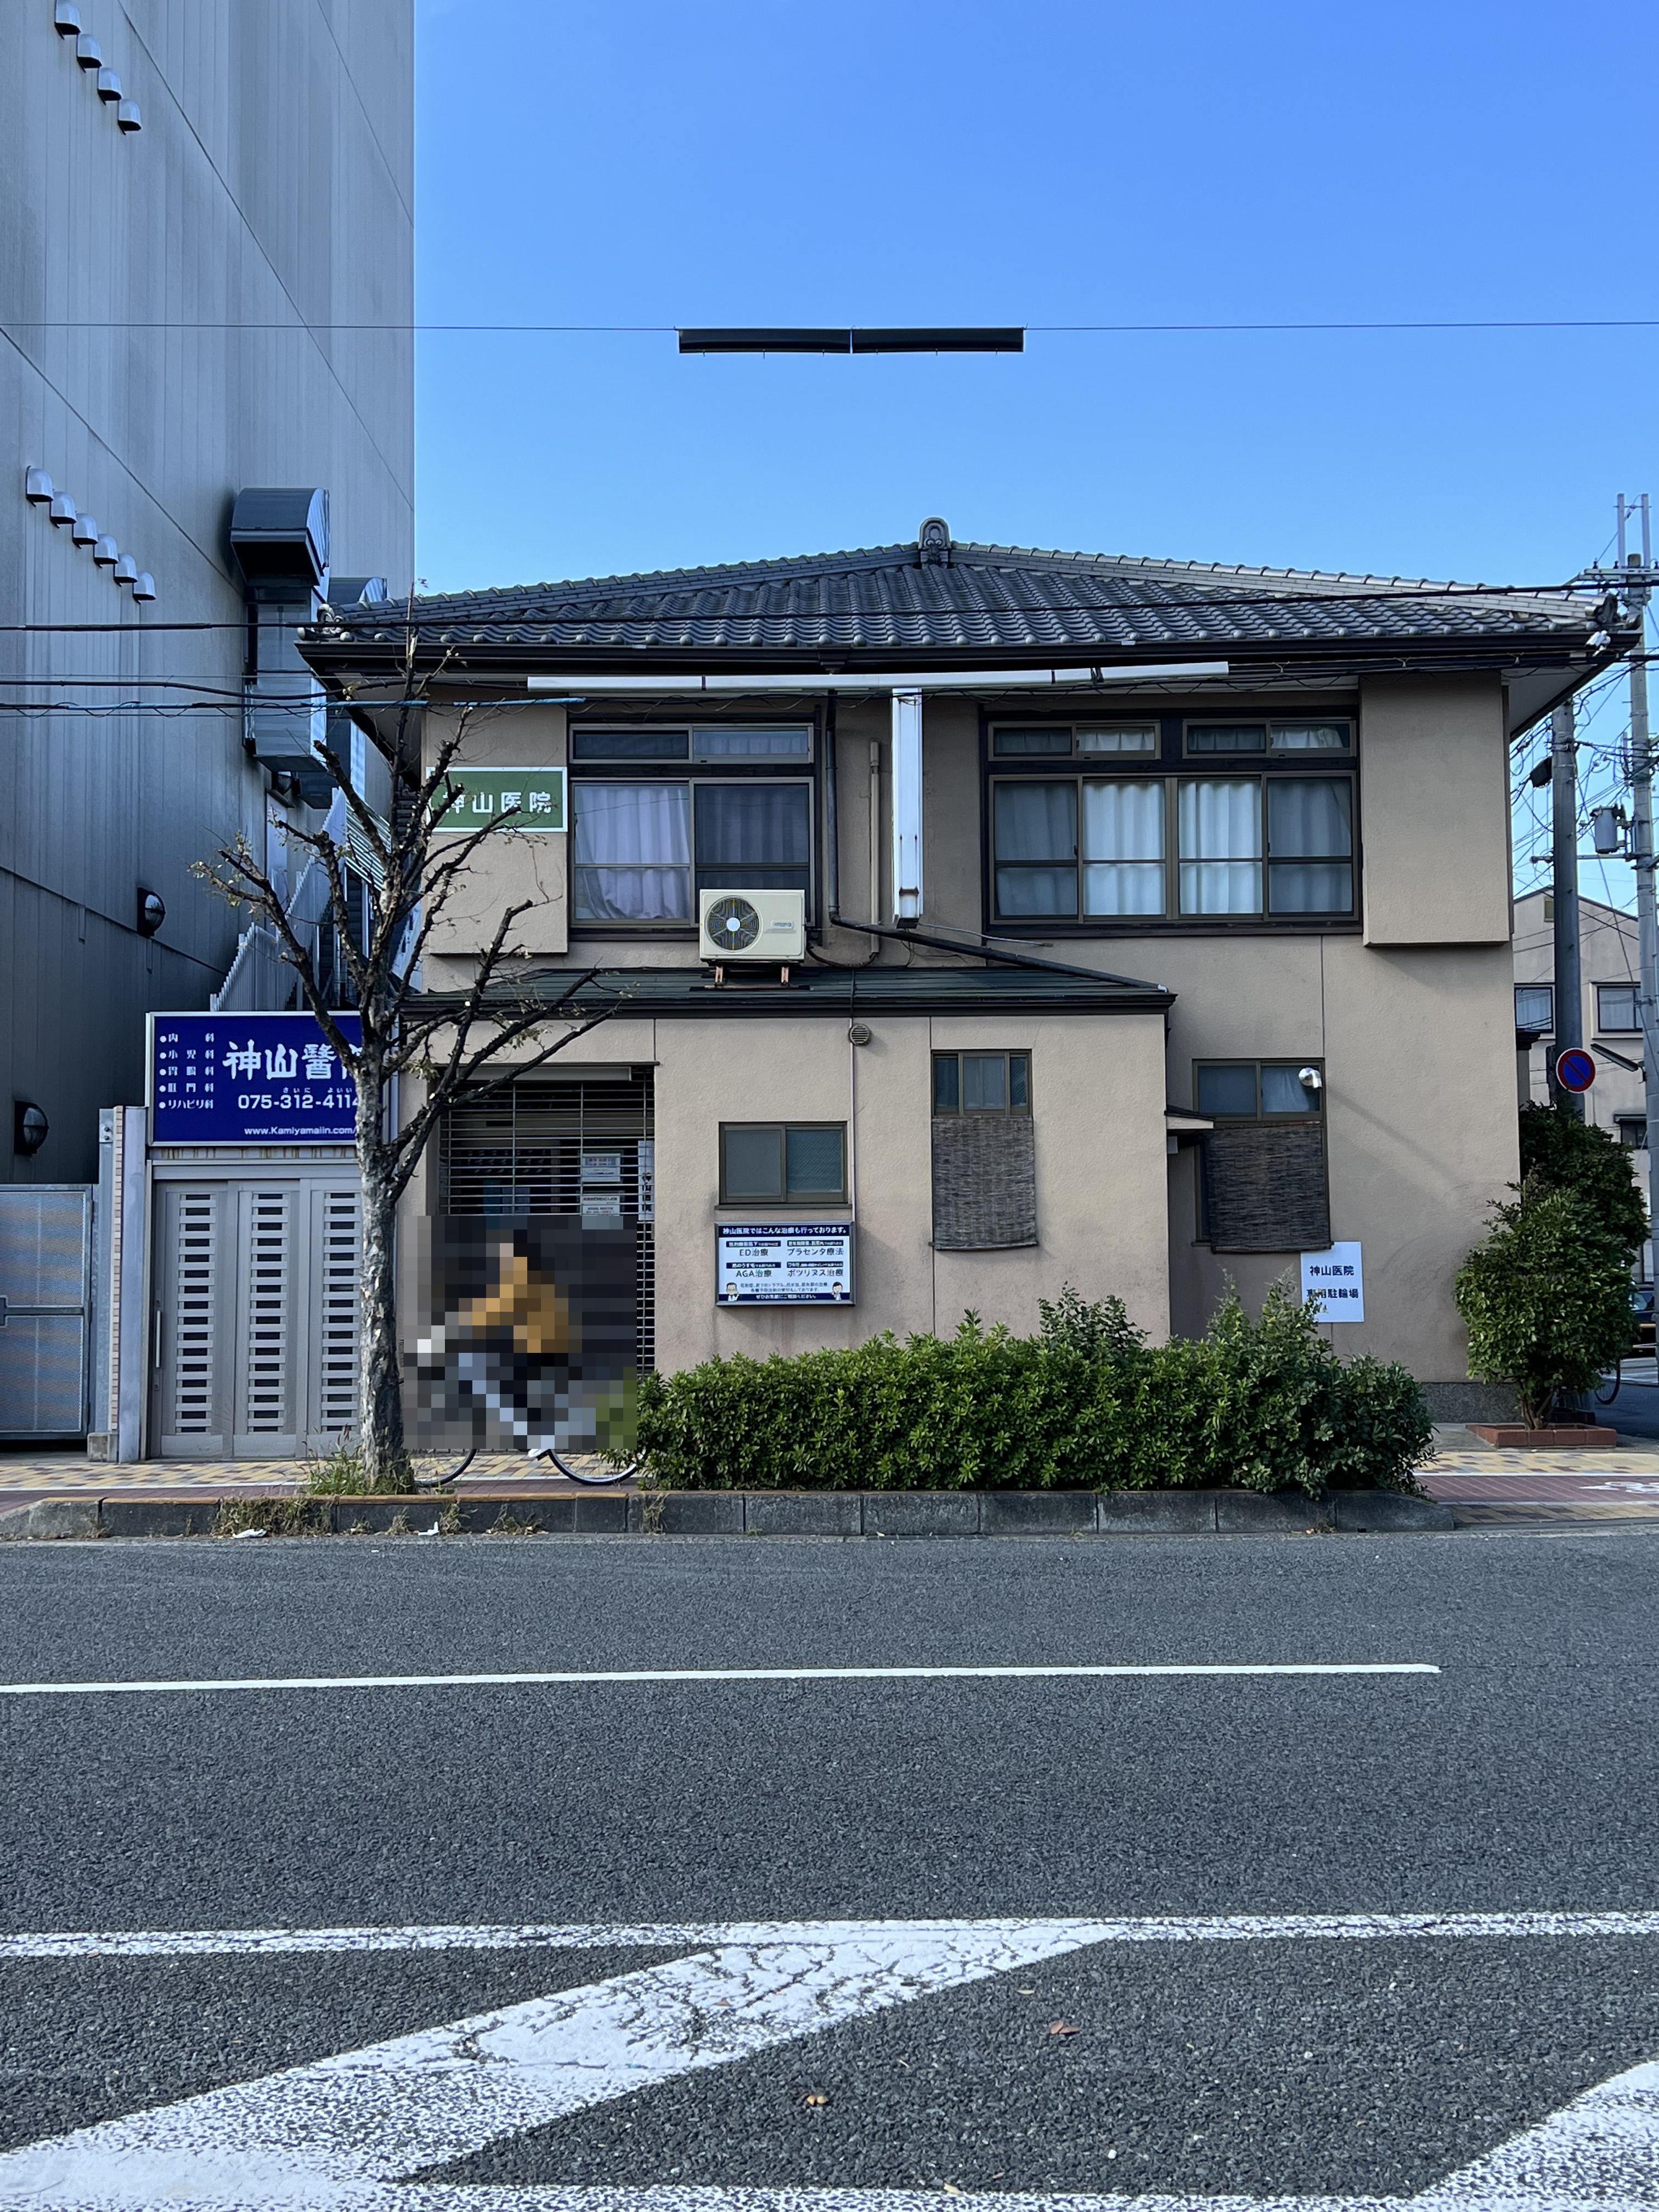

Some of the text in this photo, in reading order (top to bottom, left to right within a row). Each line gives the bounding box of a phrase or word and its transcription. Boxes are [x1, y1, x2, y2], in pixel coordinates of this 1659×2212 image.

[168, 1033, 214, 1042] 内科
[168, 1049, 214, 1059] 小児科
[168, 1099, 213, 1109] リハビリ科
[1310, 1265, 1355, 1276] 神山医院
